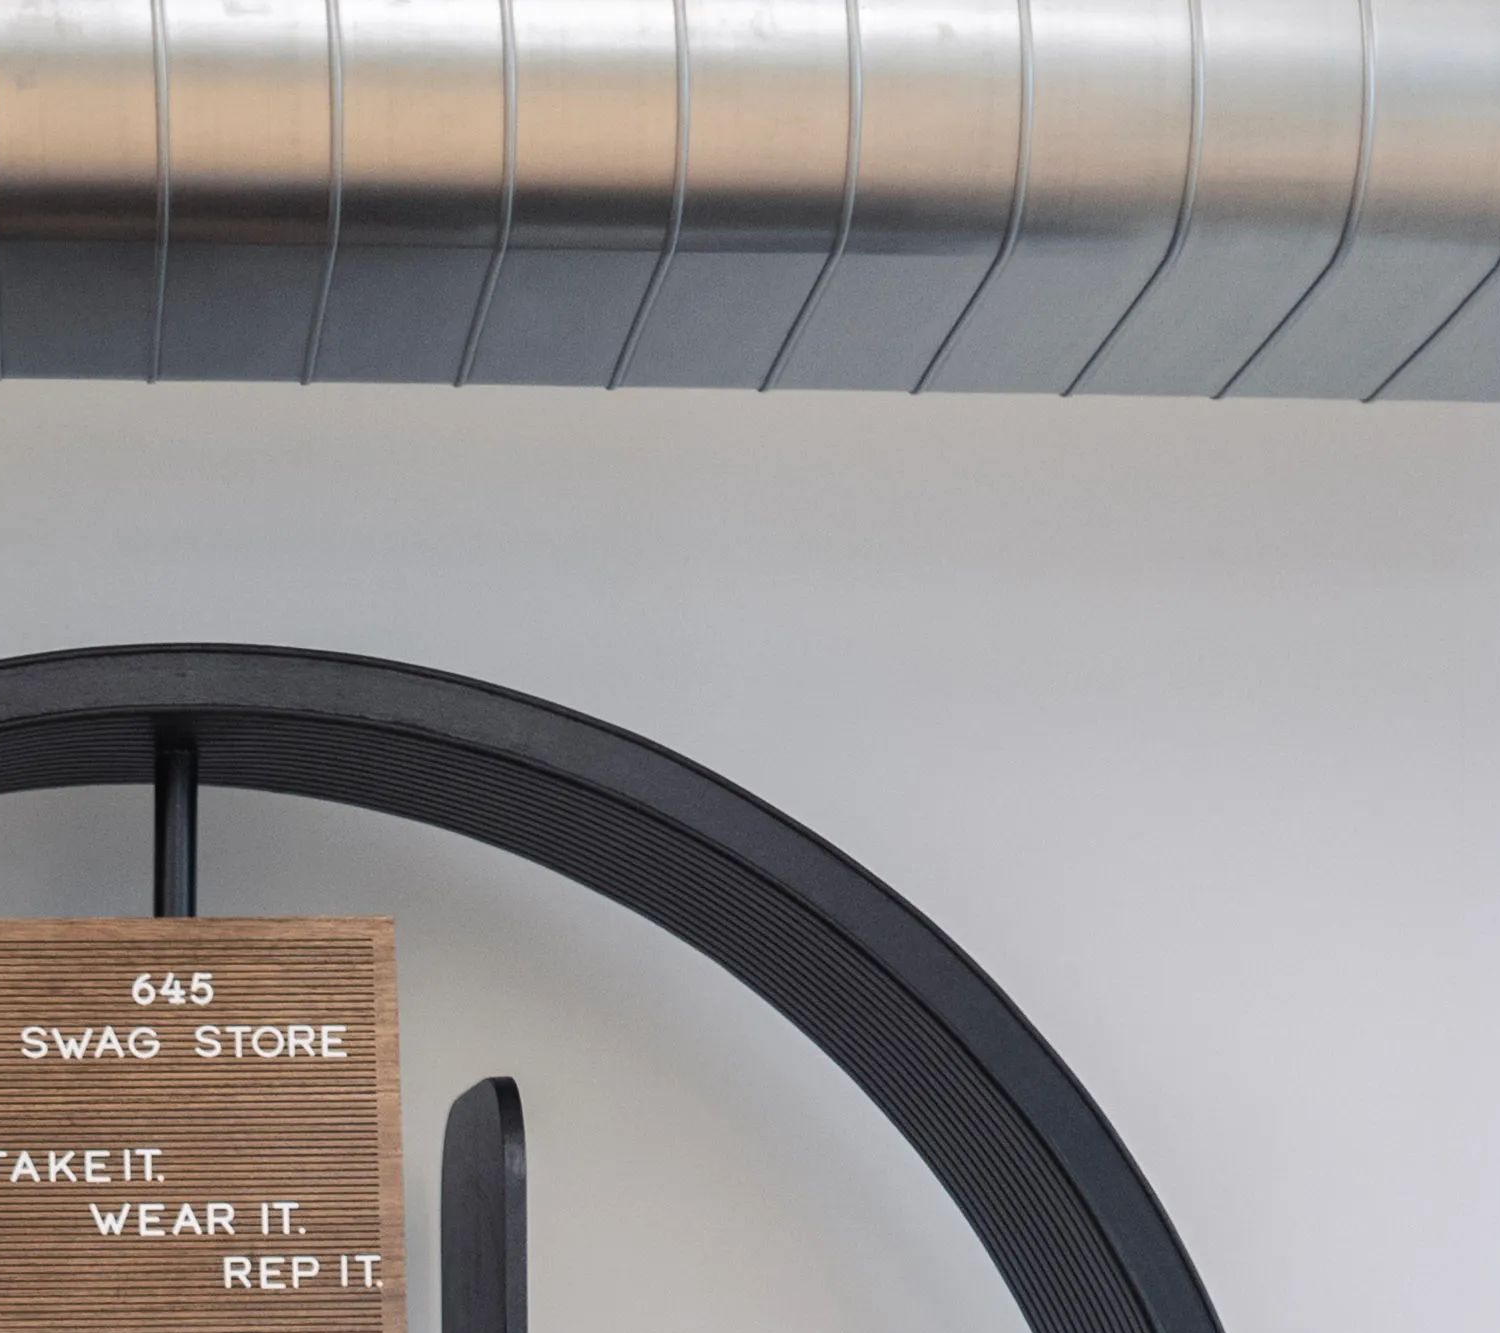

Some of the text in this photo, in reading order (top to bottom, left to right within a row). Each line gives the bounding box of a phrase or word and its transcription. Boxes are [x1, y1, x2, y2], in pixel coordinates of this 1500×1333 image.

[131, 972, 215, 1005] 645
[20, 1025, 348, 1060] SWAG STORE
[123, 1148, 165, 1183] IT.
[89, 1201, 307, 1236] WEAR IT.
[223, 1254, 384, 1289] REP IT.
